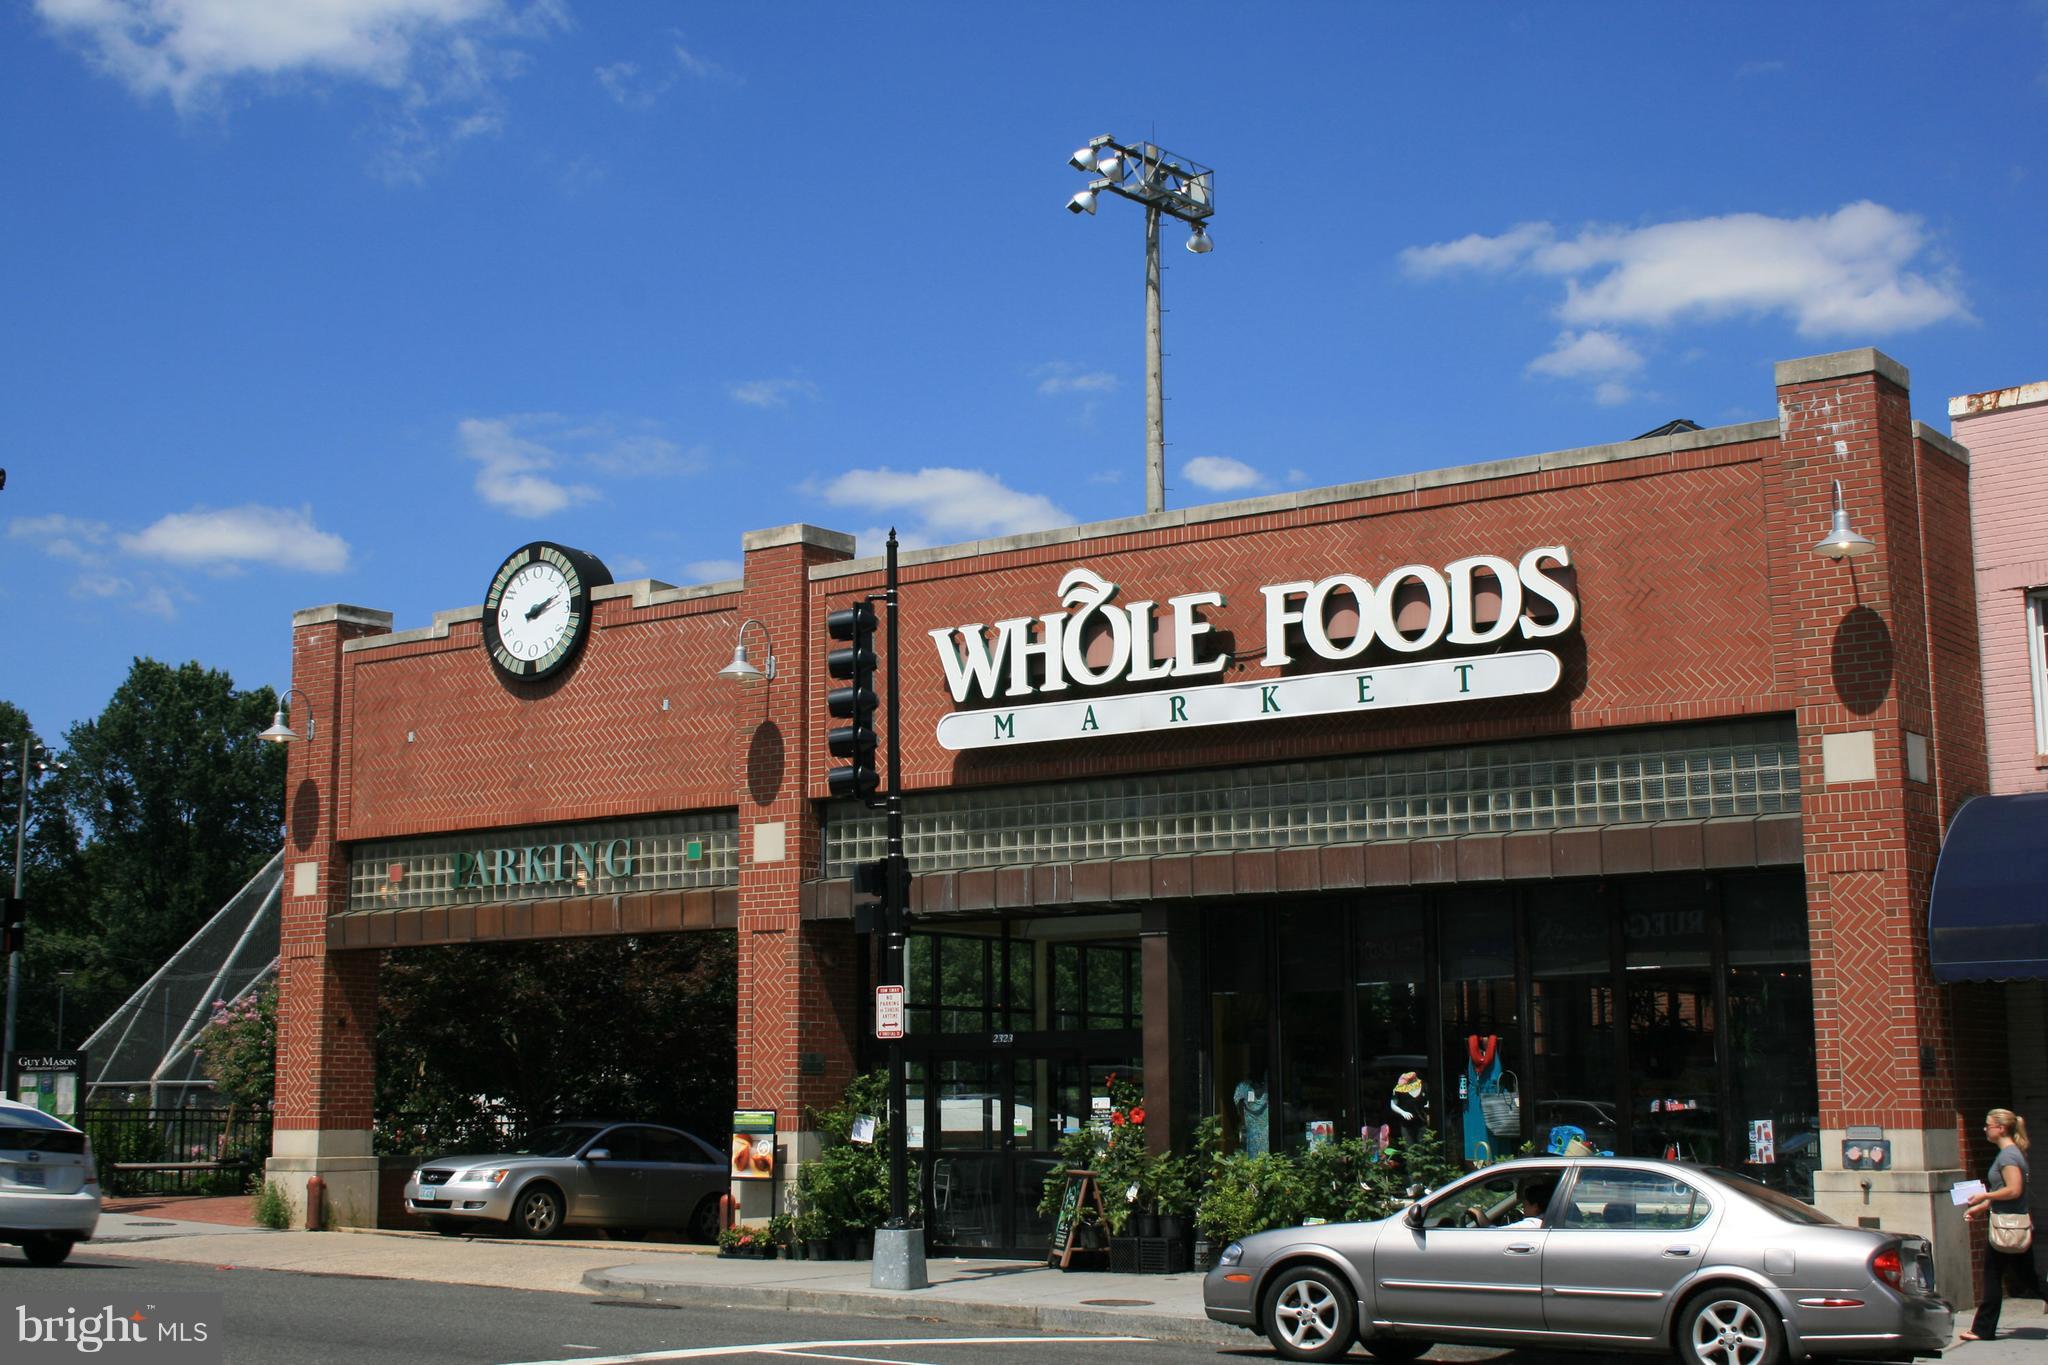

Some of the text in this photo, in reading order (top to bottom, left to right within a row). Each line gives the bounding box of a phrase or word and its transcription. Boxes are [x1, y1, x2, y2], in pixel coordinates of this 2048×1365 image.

[505, 564, 566, 601] WHOLE
[500, 608, 509, 622] 9
[563, 600, 570, 614] 3
[927, 545, 1577, 703] WHOLE FOODS
[503, 623, 565, 658] FOODS
[992, 664, 1475, 740] MARKET
[452, 837, 633, 889] PARKING
[992, 1033, 1014, 1043] 2323
